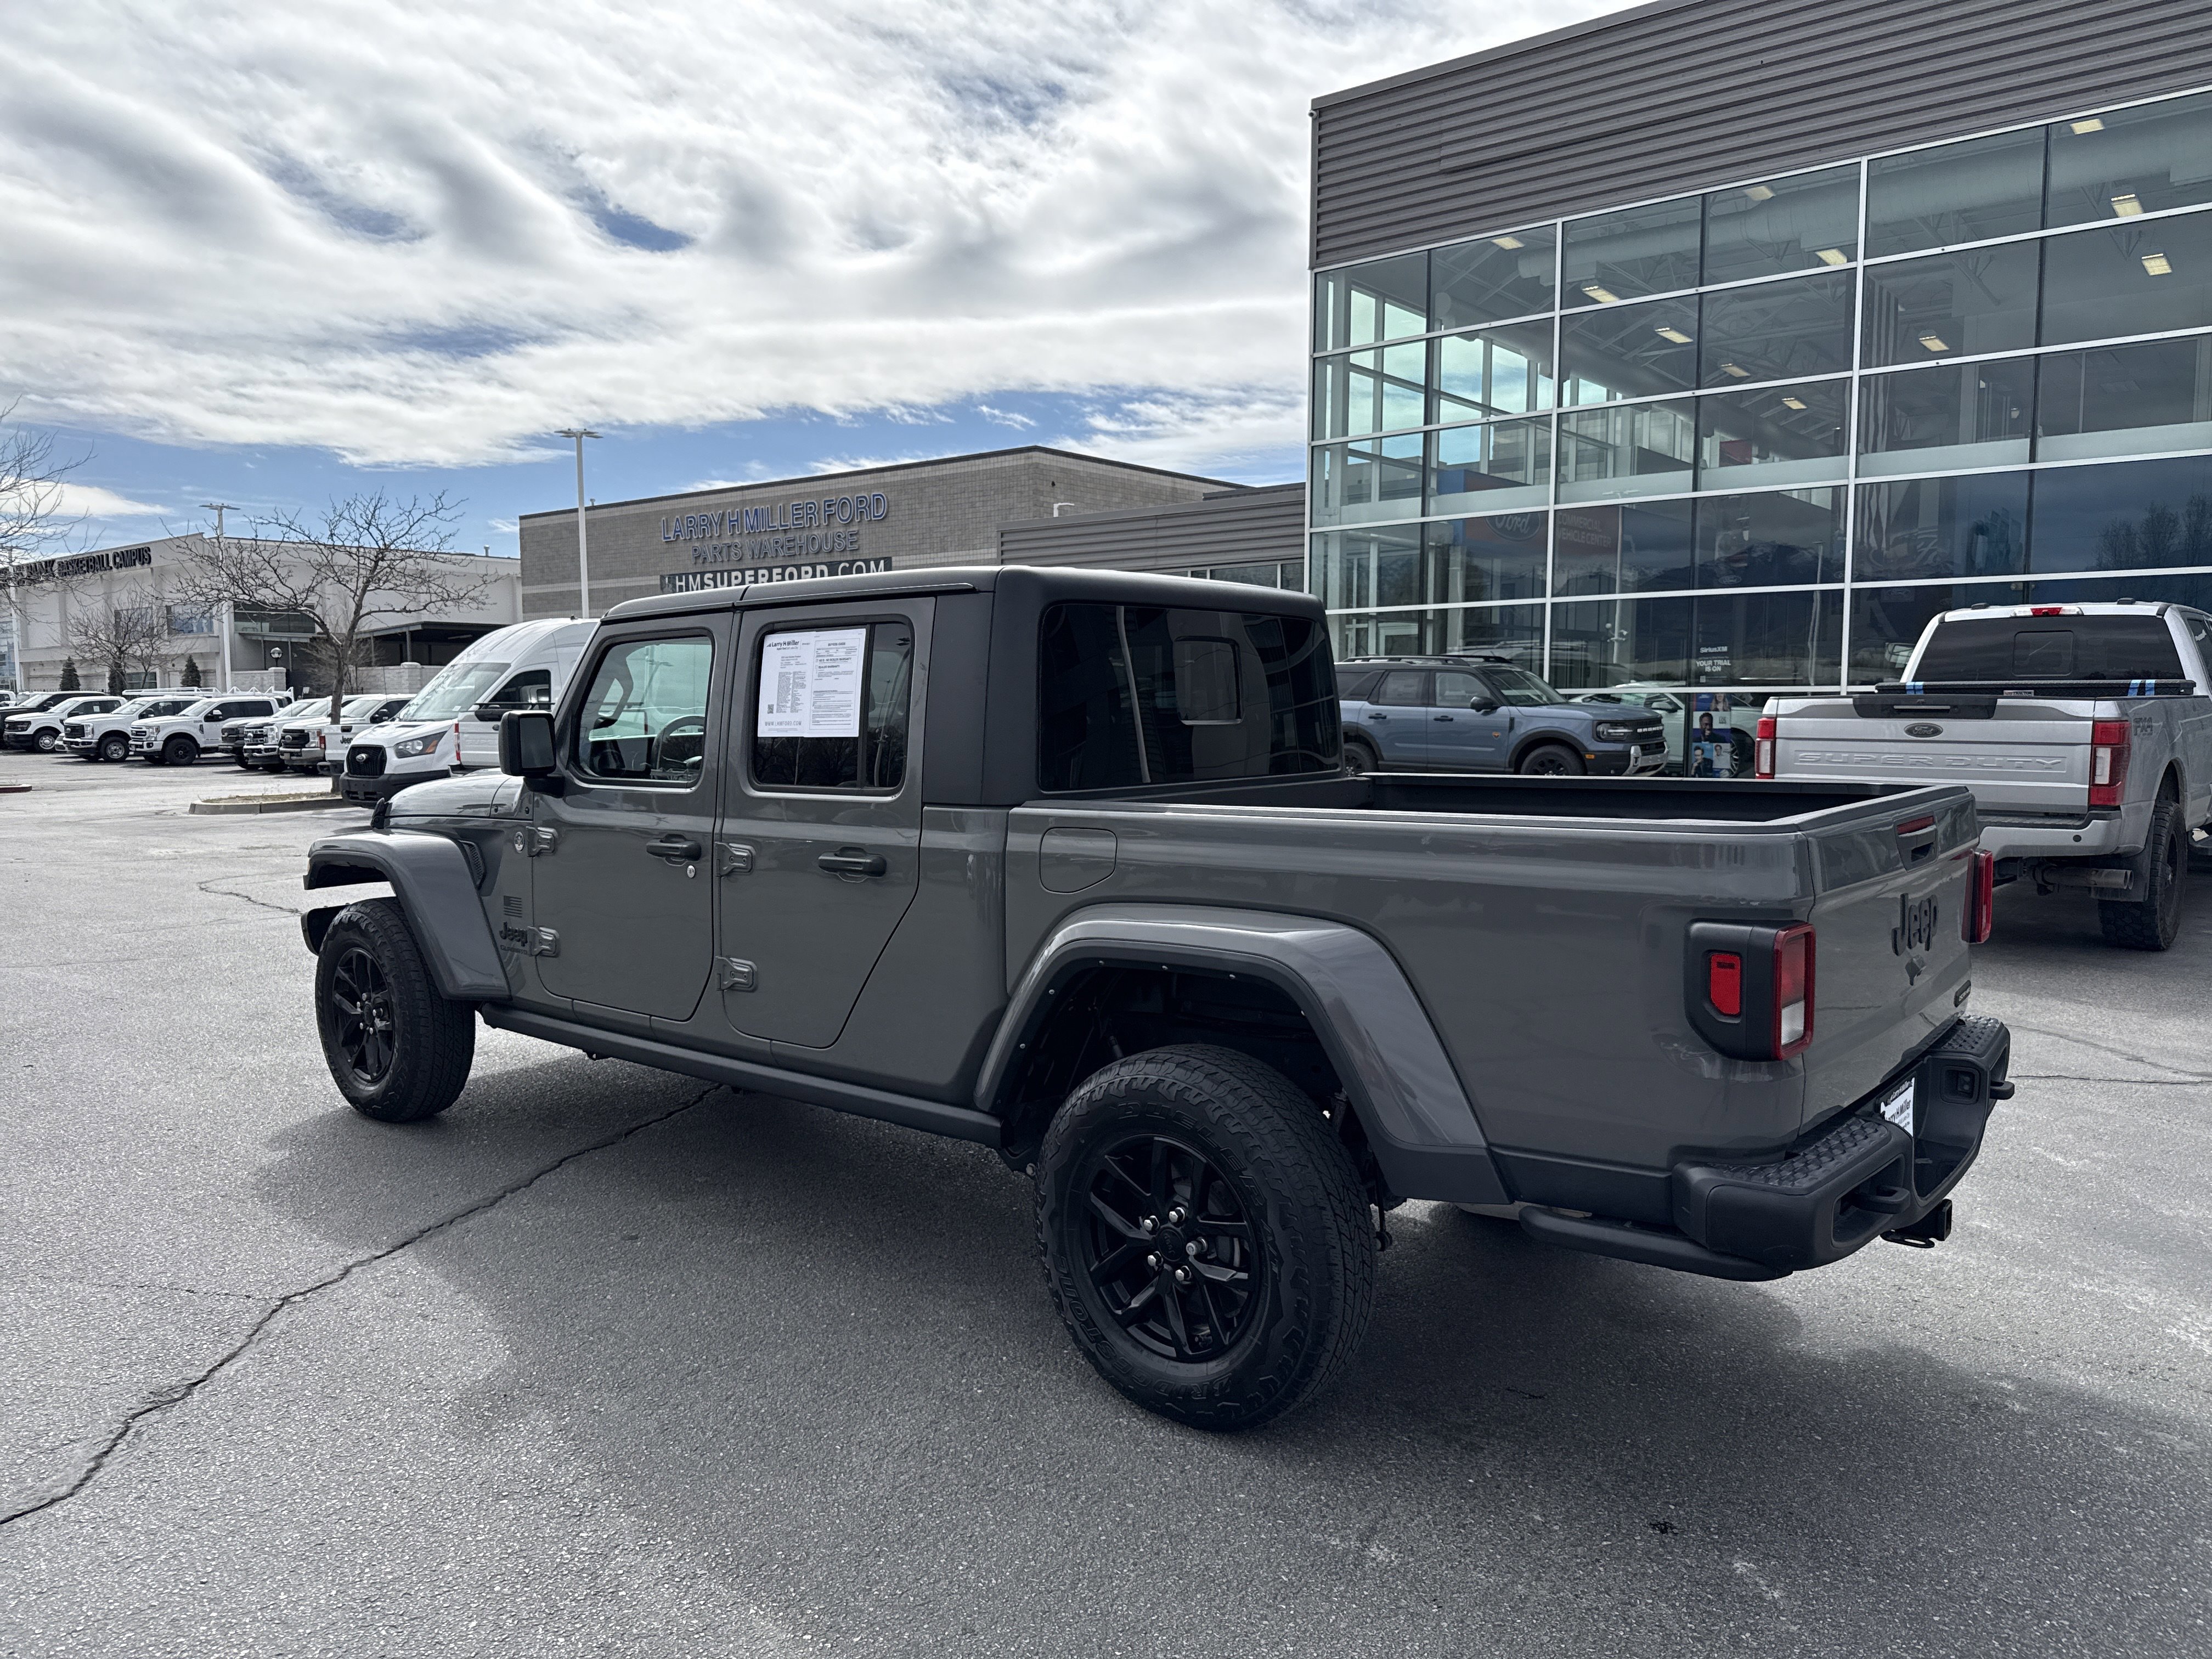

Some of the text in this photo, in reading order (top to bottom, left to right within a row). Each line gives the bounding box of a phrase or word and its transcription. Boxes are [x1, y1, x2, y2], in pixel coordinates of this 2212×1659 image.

[662, 493, 888, 541] LARRY H MILLER FORD
[1557, 512, 1602, 532] COMMERCIAL
[692, 530, 859, 564] PARTS WAREHOUSE
[1557, 527, 1612, 548] VEHICLE CENTER
[57, 554, 112, 576] BASKETBALL
[112, 546, 151, 569] CAMPUS
[1912, 726, 1934, 735] Ford
[2133, 717, 2153, 736] FX4
[1798, 753, 2062, 769] SUPER DUTY
[499, 922, 528, 947] Jeep
[1892, 893, 1939, 956] Jeep
[1116, 1101, 1265, 1206] DUELER
[1056, 1256, 1233, 1400] BRIDGESTONE
